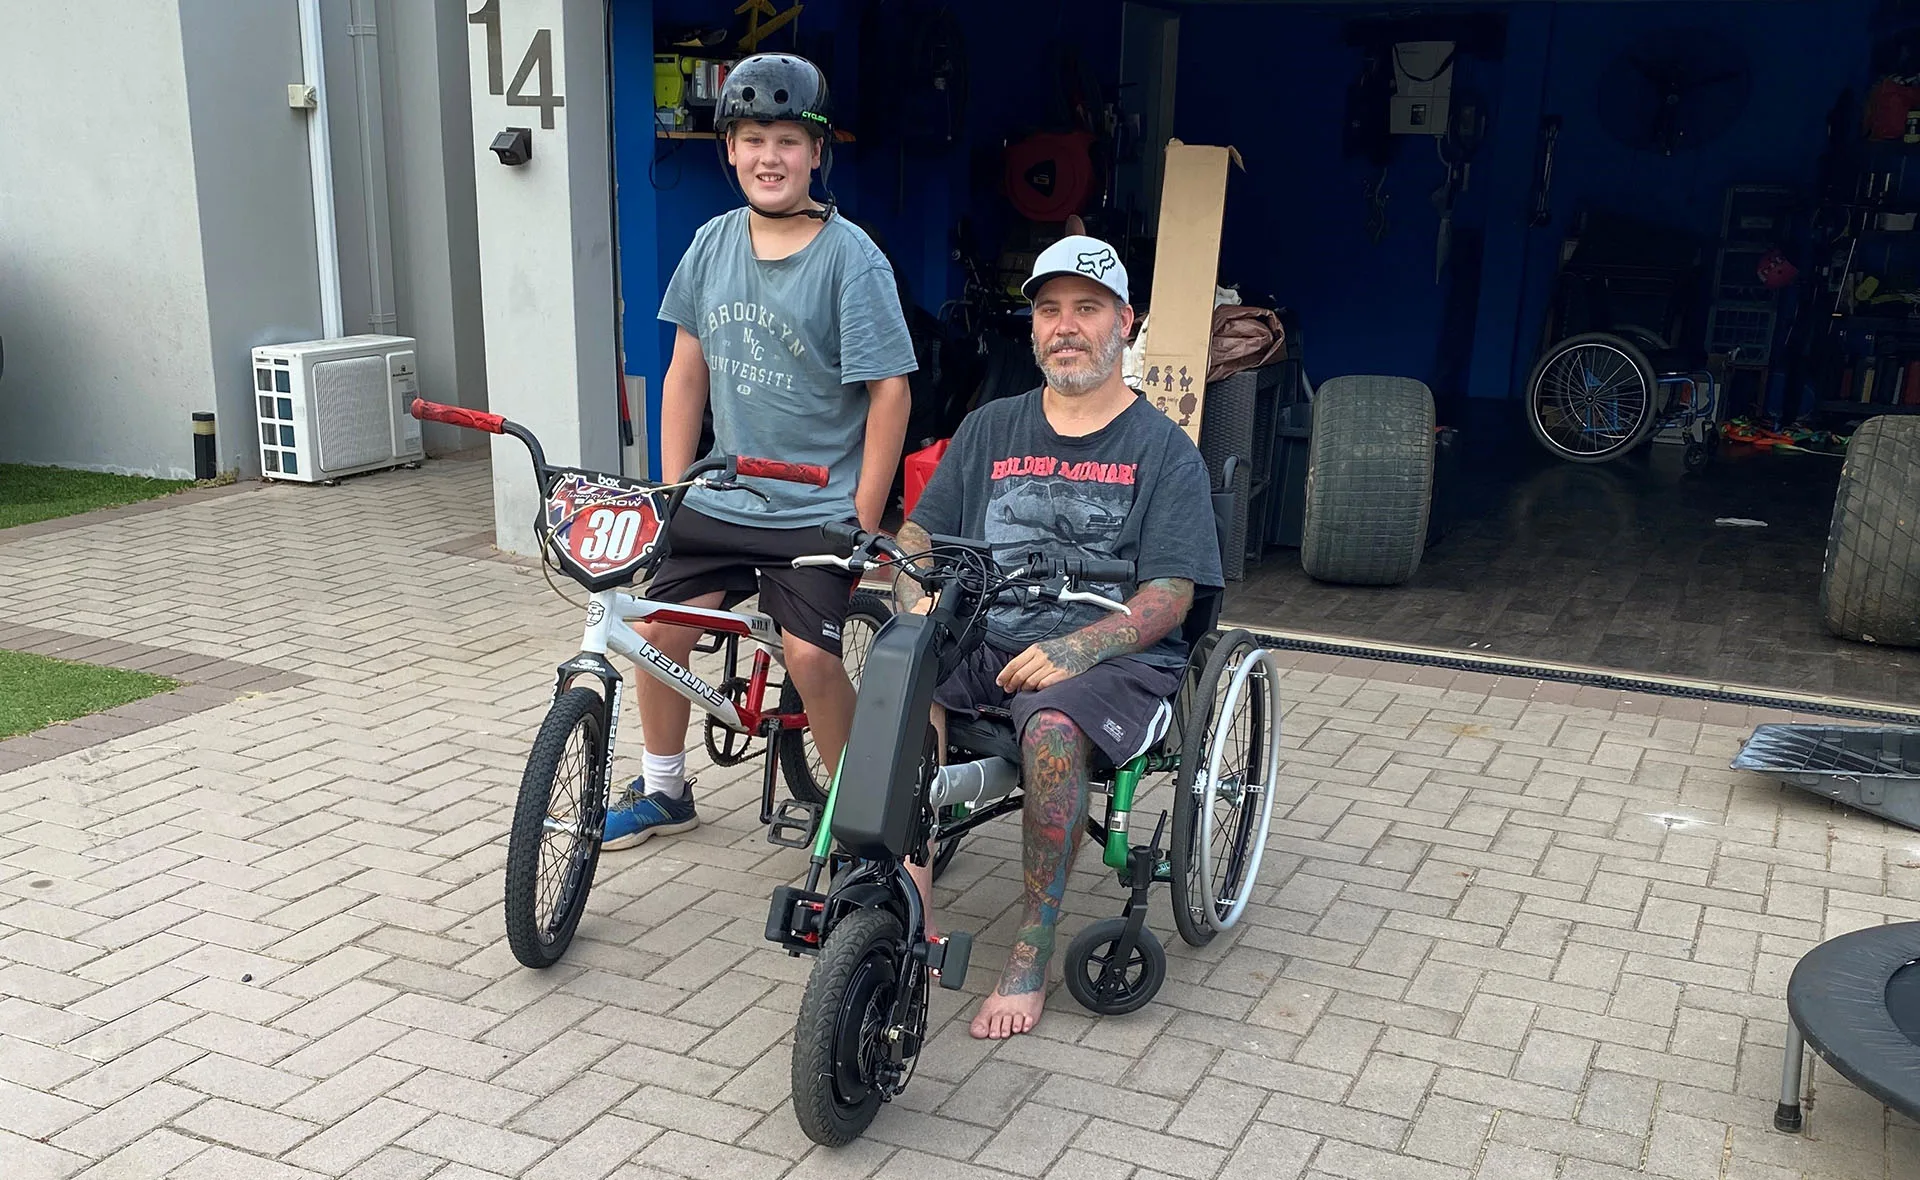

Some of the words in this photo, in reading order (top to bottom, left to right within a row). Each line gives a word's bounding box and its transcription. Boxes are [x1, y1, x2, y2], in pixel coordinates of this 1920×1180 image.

[468, 0, 565, 129] 14
[708, 302, 805, 357] BROOKLYN
[743, 327, 765, 361] NYC
[711, 355, 793, 389] UNIVERSITY
[597, 473, 620, 488] box
[580, 508, 641, 561] 30
[640, 642, 726, 707] REDLINE
